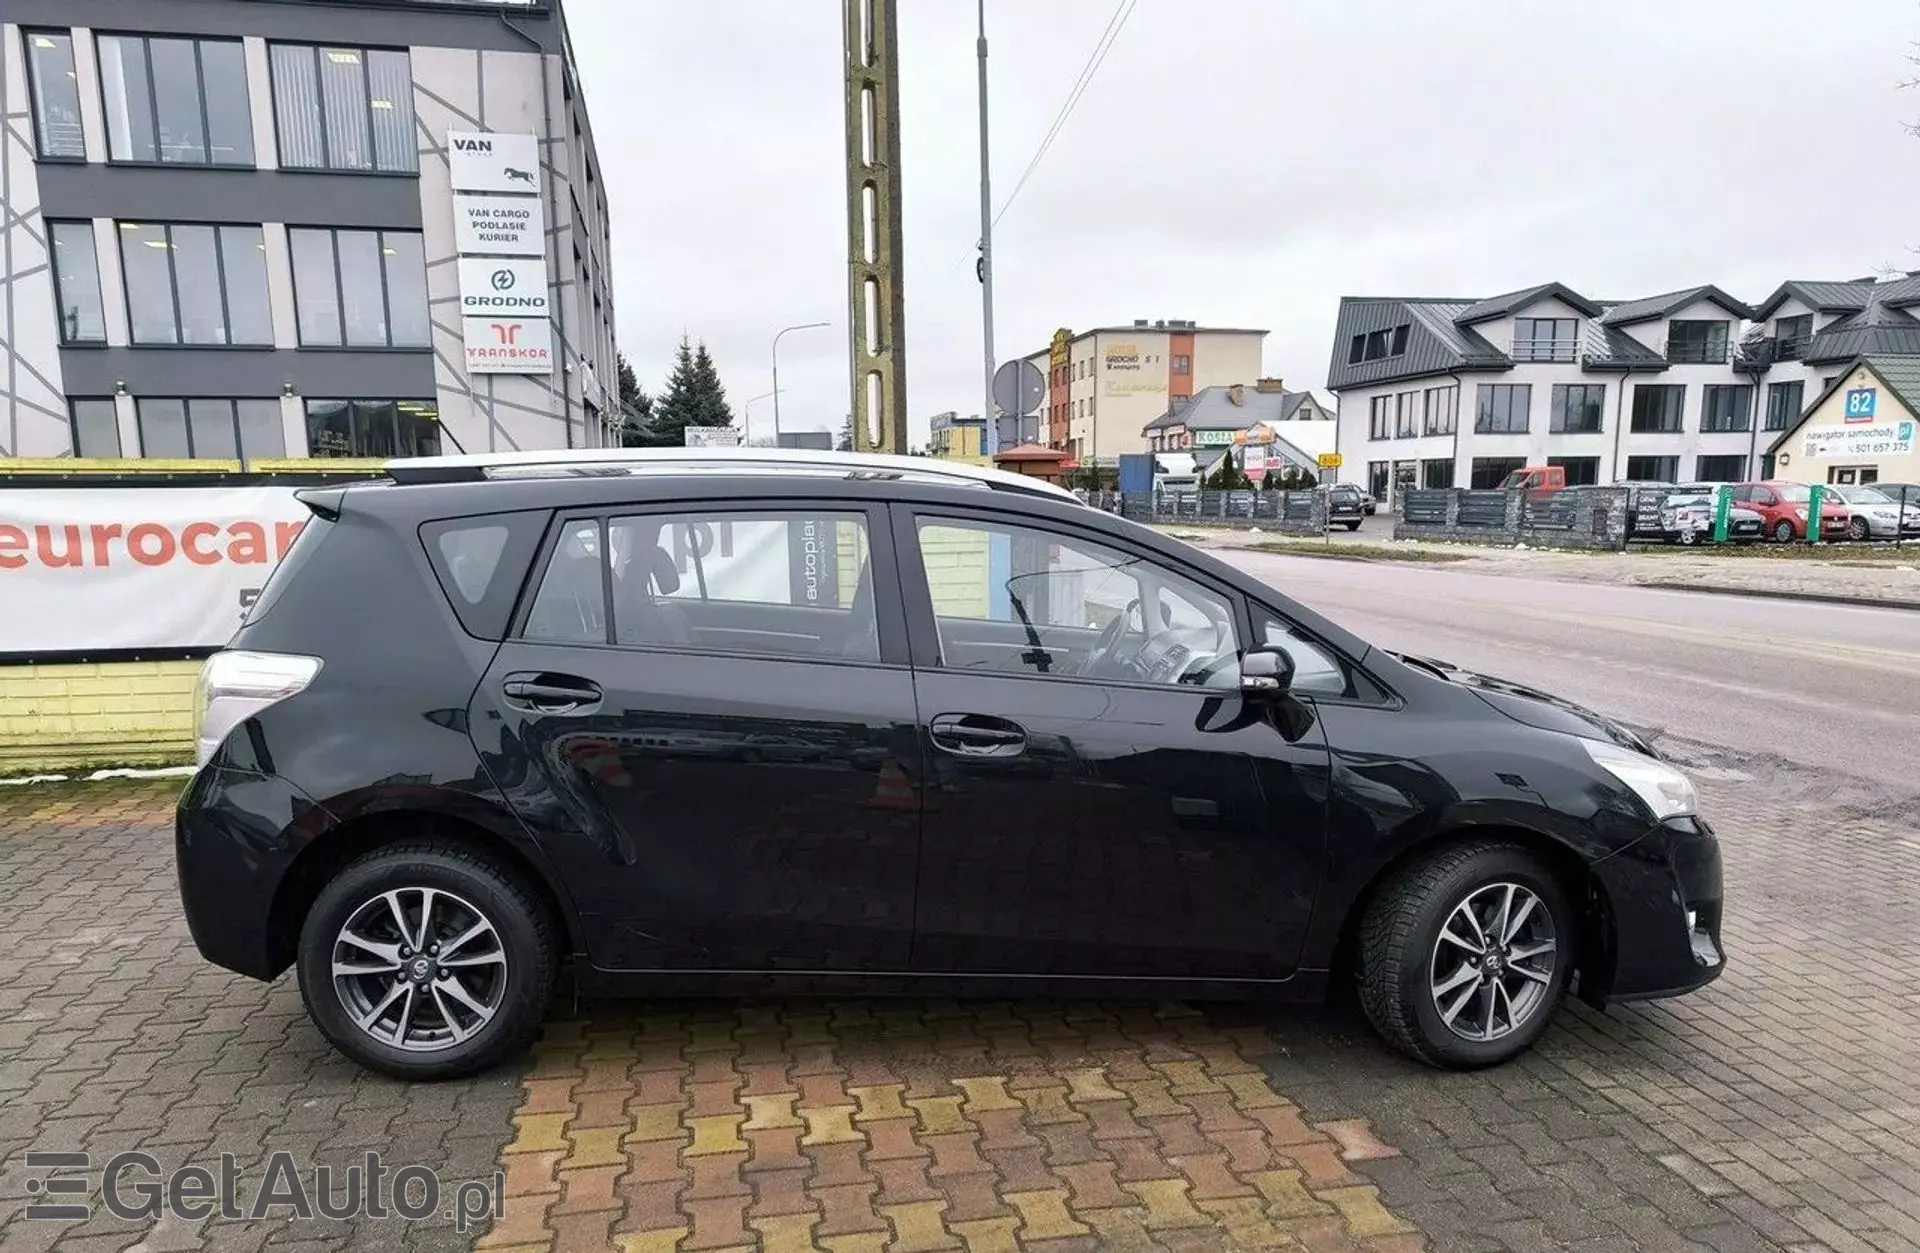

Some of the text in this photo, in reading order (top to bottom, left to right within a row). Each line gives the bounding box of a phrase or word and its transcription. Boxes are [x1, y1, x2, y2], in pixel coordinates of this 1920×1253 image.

[453, 139, 492, 151] VAN
[468, 208, 530, 219] VAN CARGO
[472, 220, 526, 230] PODLASIE
[478, 233, 519, 242] KURIER
[464, 296, 545, 307] GRODNO
[1849, 391, 1872, 413] 82
[1855, 443, 1871, 453] 501
